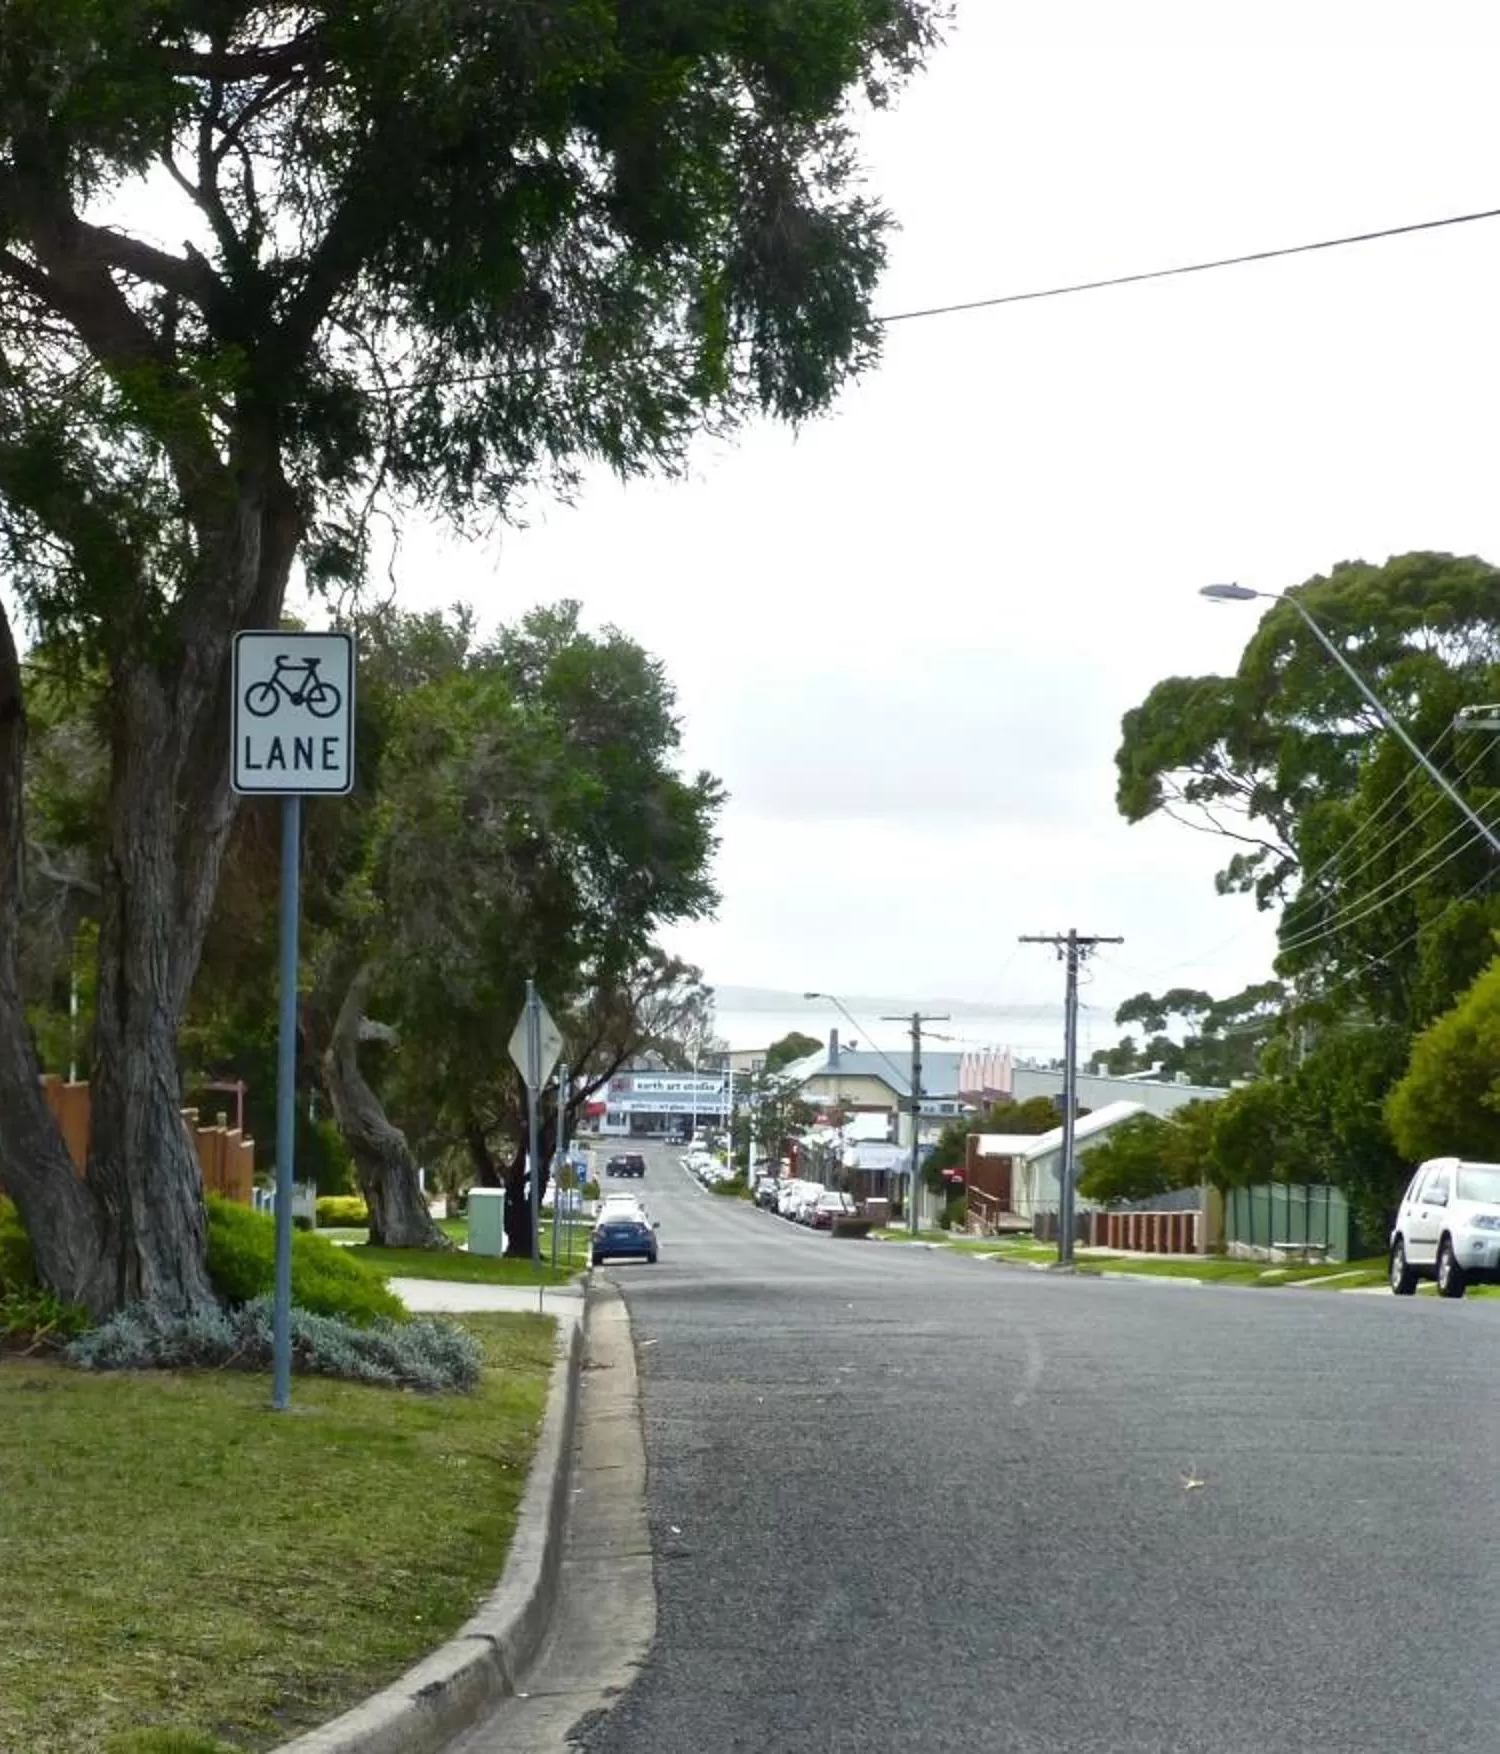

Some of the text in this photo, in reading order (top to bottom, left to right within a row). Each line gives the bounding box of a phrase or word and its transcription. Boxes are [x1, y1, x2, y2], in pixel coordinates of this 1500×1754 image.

[244, 735, 340, 771] LANE
[637, 1080, 665, 1090] earth
[667, 1082, 681, 1091] art
